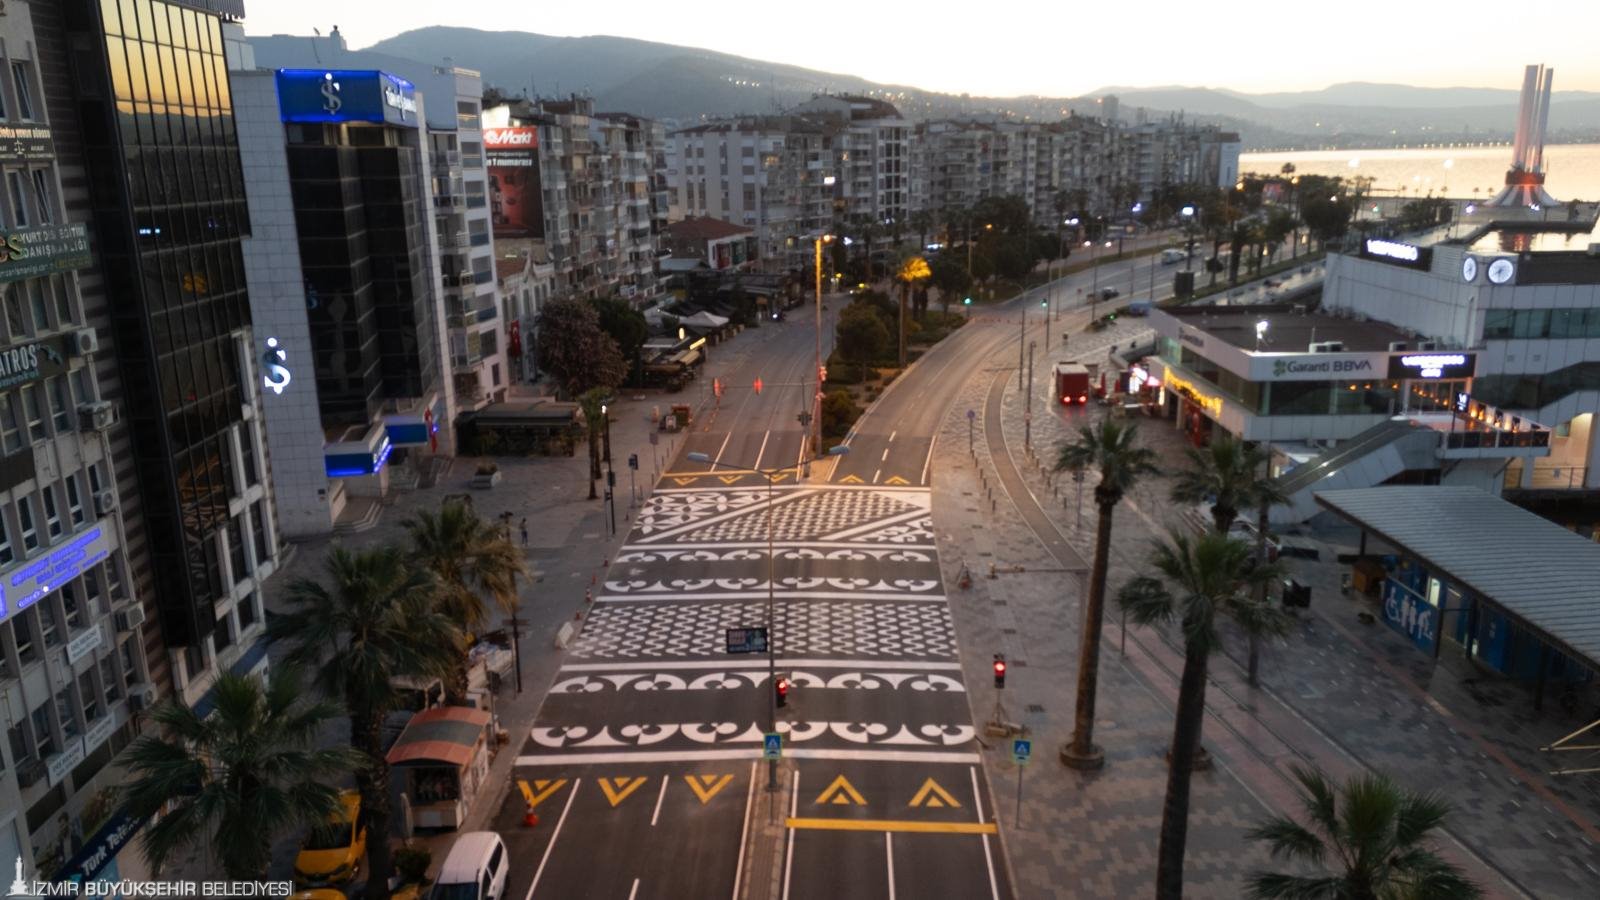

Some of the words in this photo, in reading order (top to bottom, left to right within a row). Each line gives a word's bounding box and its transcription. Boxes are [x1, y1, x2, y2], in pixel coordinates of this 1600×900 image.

[496, 130, 532, 145] Markt
[1287, 359, 1330, 374] Garanti
[1333, 359, 1372, 373] BBVA
